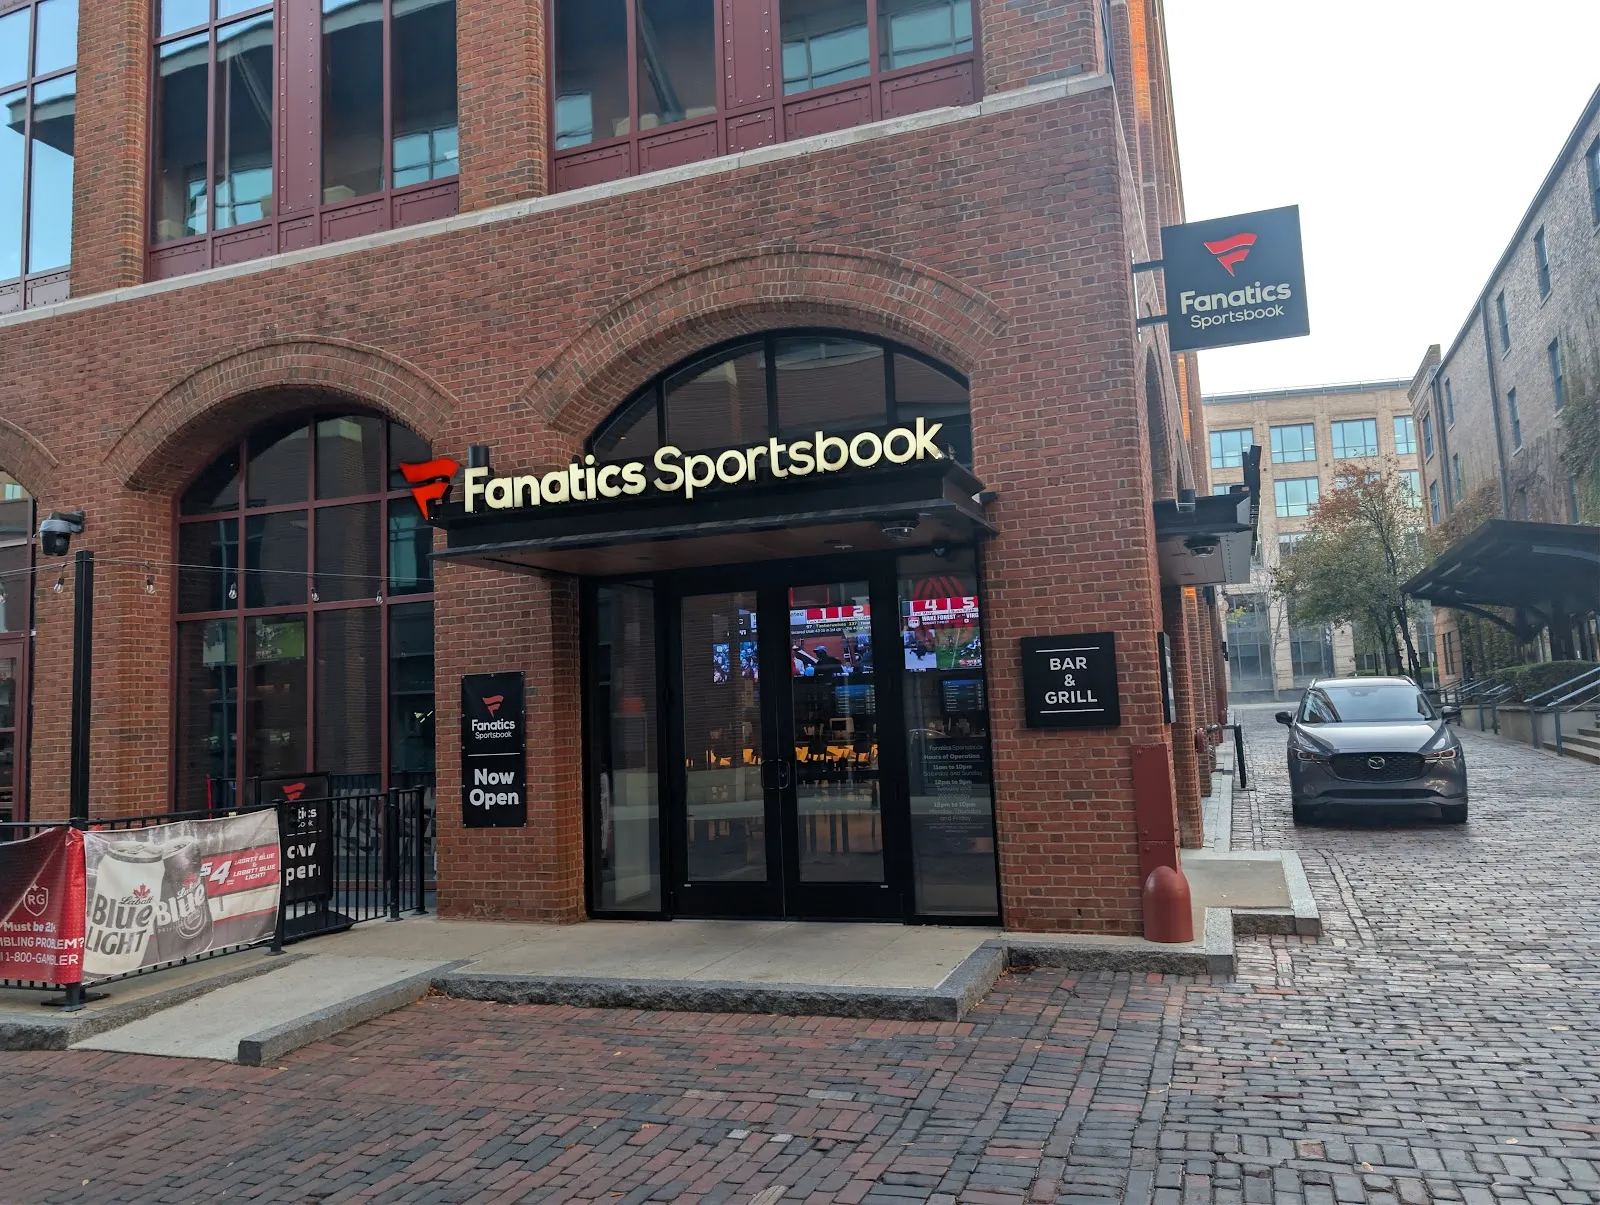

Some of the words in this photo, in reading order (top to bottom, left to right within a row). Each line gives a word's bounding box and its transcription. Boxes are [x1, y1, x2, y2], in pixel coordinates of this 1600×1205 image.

[1179, 281, 1292, 315] Fanatics
[1190, 304, 1285, 330] Sportsbook
[464, 454, 647, 513] Fanatics
[653, 416, 943, 500] Sportsbook
[962, 597, 975, 609] 5
[852, 605, 864, 617] 2
[1049, 656, 1088, 671] BAR
[1063, 673, 1076, 687] &
[1044, 690, 1098, 705] GRILL
[471, 718, 516, 732] Fanatics
[474, 731, 513, 741] Sportsbook
[949, 753, 980, 761] Operation
[474, 768, 515, 786] Now
[469, 788, 520, 810] Open
[287, 842, 317, 859] ow
[232, 867, 258, 877] LABATT
[259, 864, 276, 872] BLUE
[285, 863, 321, 886] pen
[27, 894, 46, 905] RG
[155, 883, 206, 926] Blue
[91, 894, 154, 930] Blue
[3, 921, 32, 932] Must
[32, 921, 44, 932] be
[84, 926, 148, 956] LIGHT
